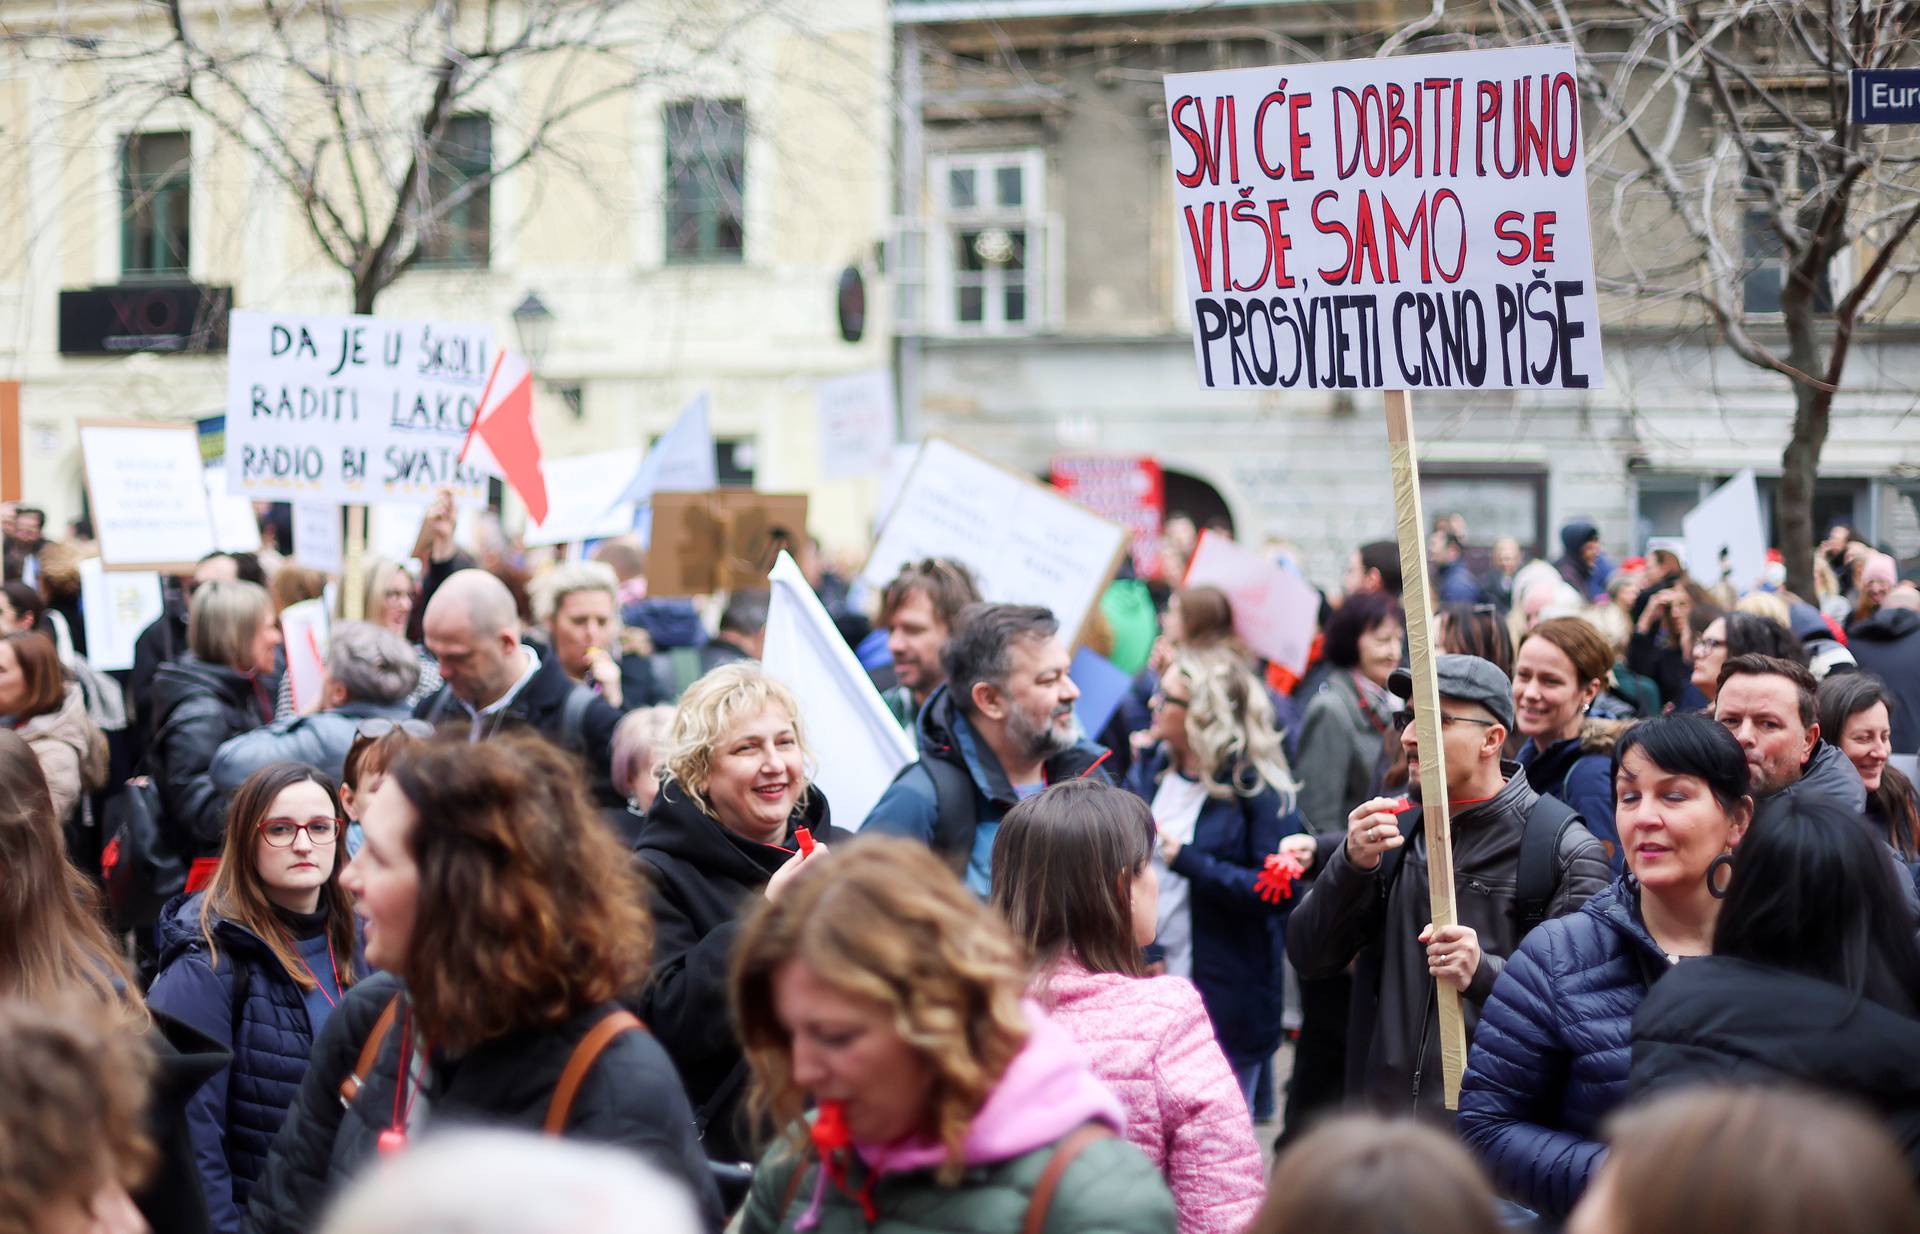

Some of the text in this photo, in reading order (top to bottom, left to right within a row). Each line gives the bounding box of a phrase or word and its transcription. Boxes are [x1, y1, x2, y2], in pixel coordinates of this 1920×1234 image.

[1872, 83, 1920, 108] Eur
[1172, 71, 1577, 188] SVI ĆE DOBITI PUNO
[1184, 186, 1557, 293] VIŠE, SAMO SE
[271, 325, 486, 376] DA JE U ŠKOLI
[1195, 269, 1589, 388] PROSVJETI CRNO PIŠE
[251, 384, 478, 429] RADITI LAKO
[242, 444, 323, 480] RADIO
[342, 446, 366, 480] BI
